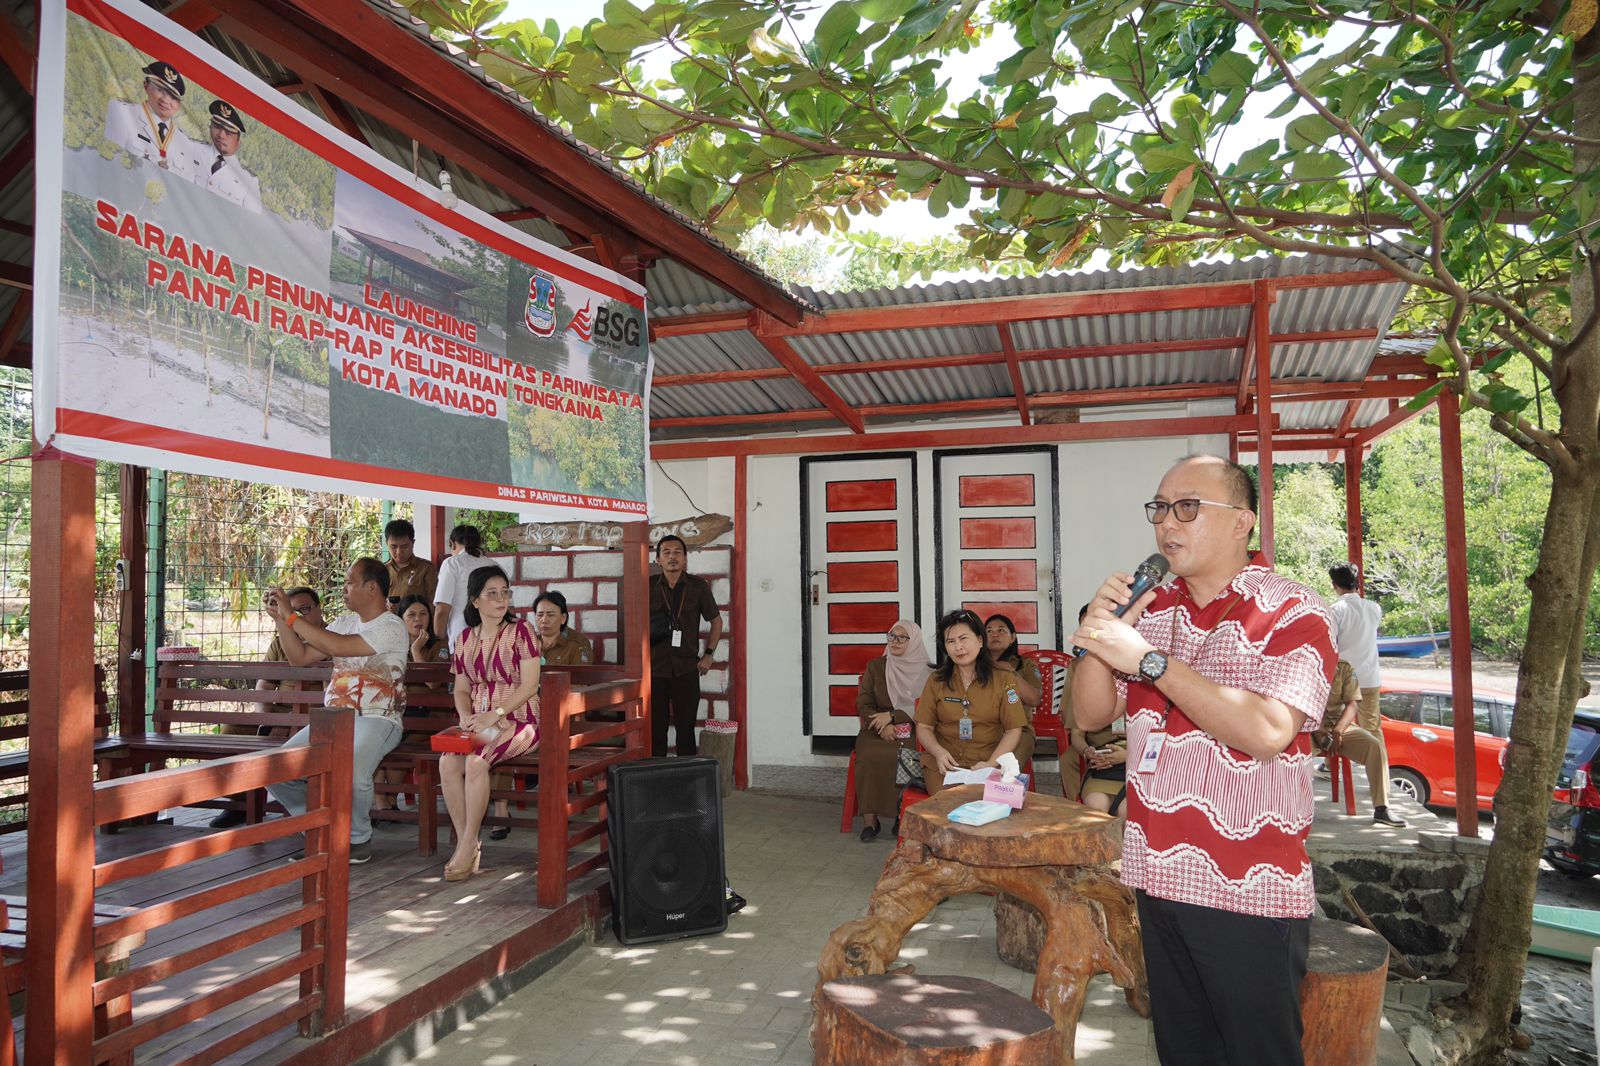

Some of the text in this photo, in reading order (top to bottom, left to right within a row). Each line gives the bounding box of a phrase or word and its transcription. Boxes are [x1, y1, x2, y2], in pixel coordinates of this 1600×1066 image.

[96, 199, 643, 410] SARANA PENUNJANG AKSESIBILITAS PARIWISATA
[363, 283, 478, 343] LAUNCHING
[594, 306, 640, 347] BSG
[147, 258, 604, 421] PANTAI RAP-RAP KELURAHAN TONGKAINA
[341, 357, 498, 418] KOTA MANADO
[497, 486, 647, 513] DINAS PARIWISATA KOTA MANADO
